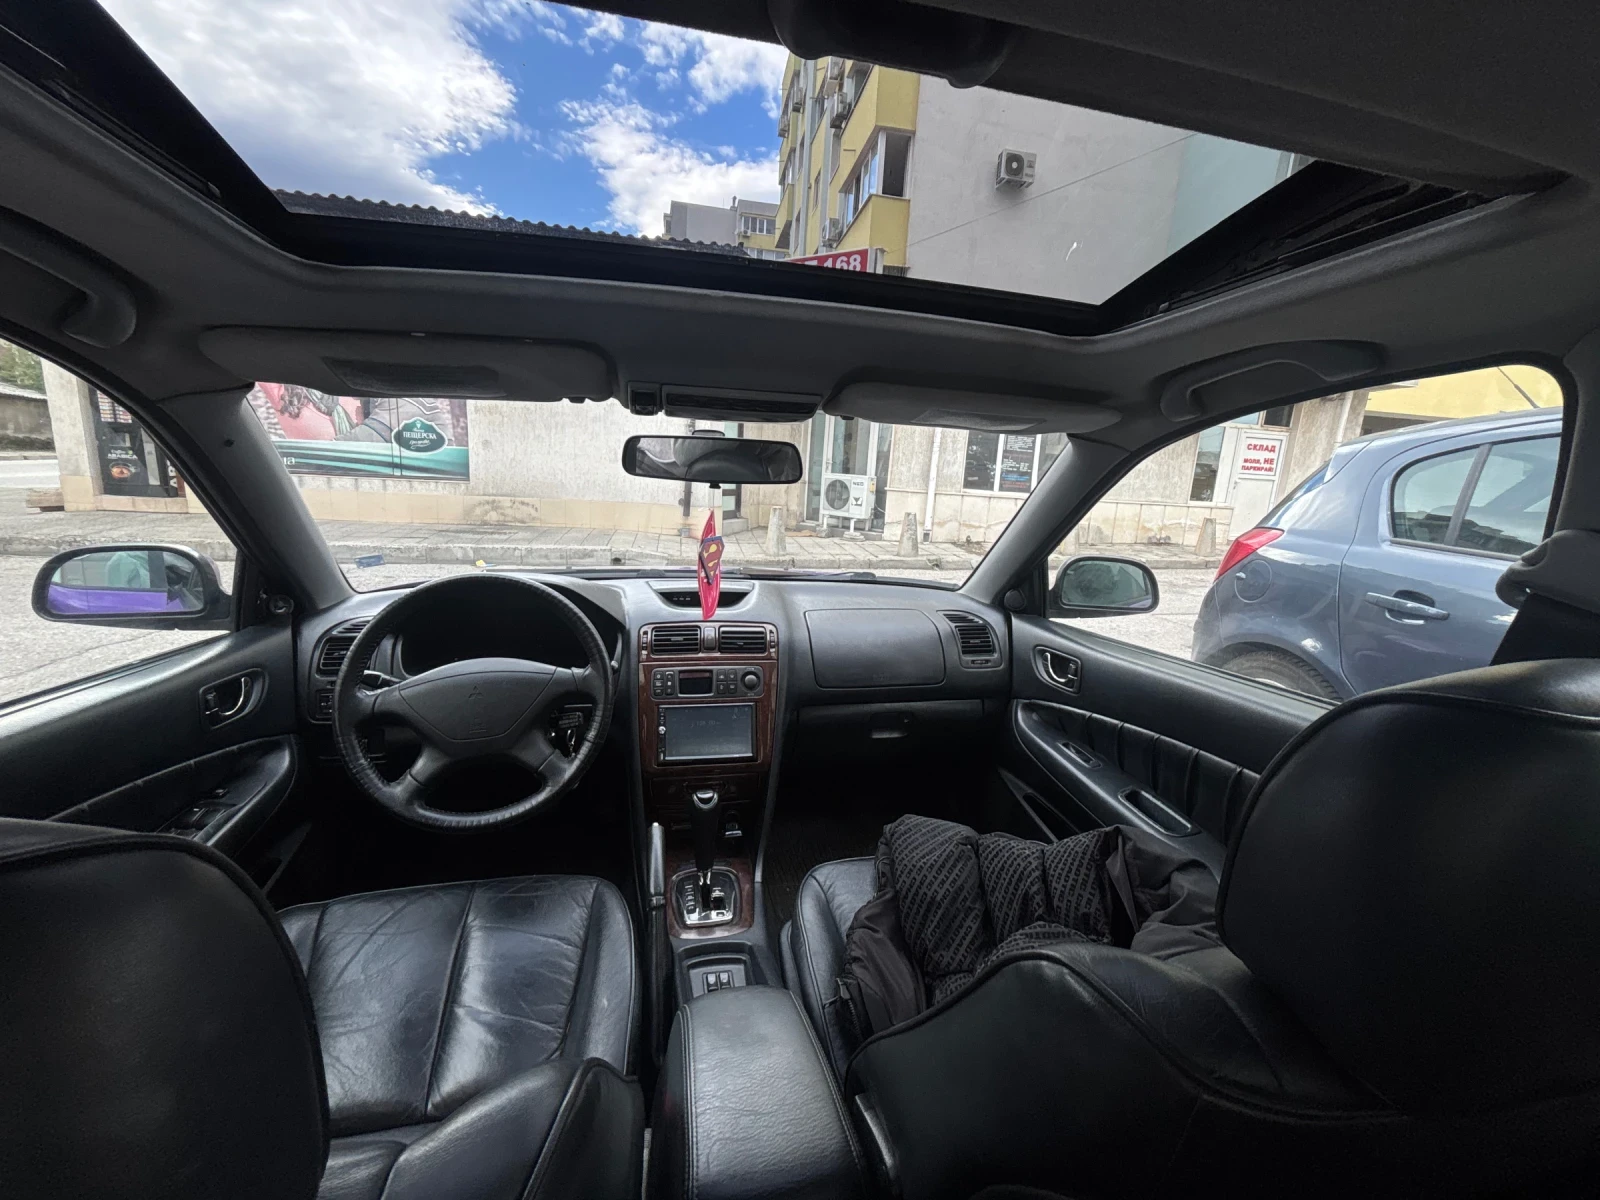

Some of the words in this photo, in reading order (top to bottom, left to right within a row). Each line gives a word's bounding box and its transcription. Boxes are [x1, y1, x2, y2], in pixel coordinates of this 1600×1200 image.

[402, 431, 438, 440] ПЕЩЕРСКА
[1247, 443, 1276, 454] СКЛАД
[1263, 457, 1275, 466] НЕ
[925, 849, 955, 890] CHAOTIC
[936, 849, 965, 890] CHAOTIC
[1057, 850, 1079, 903] CHAOTIC
[1067, 844, 1089, 896] CHAOTIC
